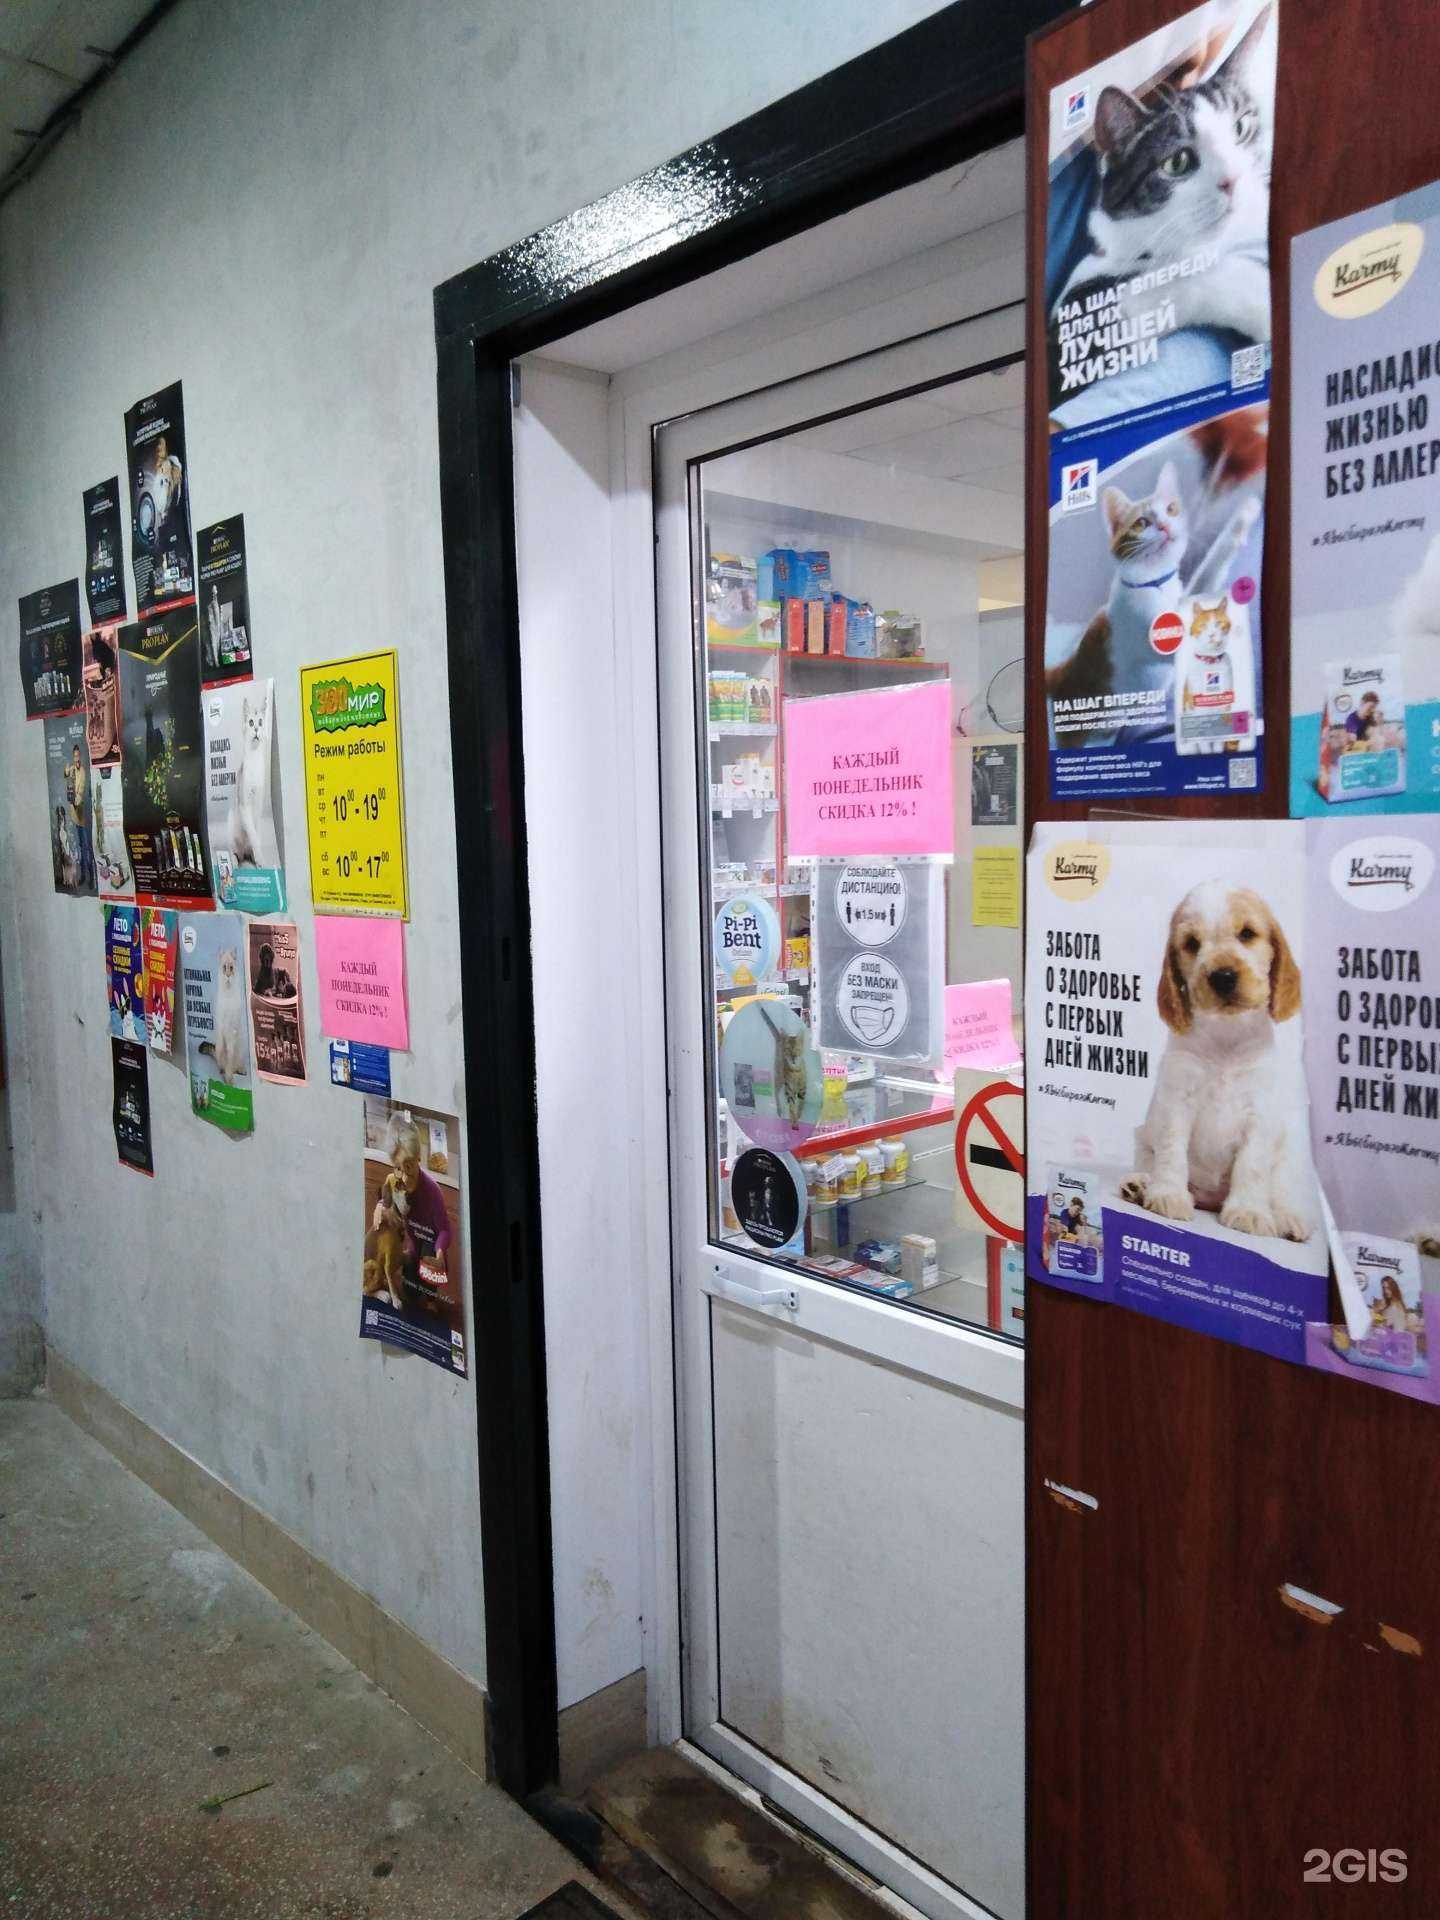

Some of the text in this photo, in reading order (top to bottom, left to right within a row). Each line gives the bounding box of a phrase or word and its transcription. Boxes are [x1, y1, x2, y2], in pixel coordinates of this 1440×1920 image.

[1335, 253, 1401, 288] Karmy
[1058, 250, 1219, 323] НА ШАГ ВПЕРЕДИ
[1058, 306, 1123, 344] ДЛЯ ИХ
[1059, 299, 1177, 366] ЛУЧШЕЙ
[1060, 337, 1159, 392] ЖИЗНИ
[1326, 394, 1428, 453] ЖИЗНЬЮ
[1326, 439, 1440, 498] БЕЗ АЛЛЕР
[1054, 690, 1167, 712] НА ШАГ ВПЕРЕДИ
[314, 739, 386, 759] Режим работы
[832, 747, 900, 770] КАЖДЫЙ
[813, 774, 924, 796] ПОНЕДЕЛЬНИК
[819, 804, 875, 820] СКИДКА
[847, 866, 896, 878] СОБЛЮДАЙТЕ
[1055, 857, 1097, 877] Karmy
[1350, 858, 1412, 881] Karmy
[724, 915, 758, 931] Pi-Pi
[723, 931, 762, 949] Bent
[1046, 930, 1100, 961] ЗАБОТА
[341, 960, 378, 977] КАЖДЫЙ
[861, 962, 881, 974] ВХОД
[1338, 947, 1421, 982] ЗАБОТА
[331, 979, 390, 998] ПОНЕДЕЛЬНИК
[848, 974, 898, 990] БЕЗ МАСКИ
[1046, 966, 1141, 1002] О ЗДОРОВЬЕ
[336, 999, 367, 1015] СКИДКА
[1046, 1002, 1123, 1038] С ПЕРВЫХ
[1338, 990, 1350, 1022] О
[1045, 1036, 1149, 1078] ДНЕЙ ЖИЗНИ
[1338, 1033, 1350, 1065] С
[1336, 1073, 1395, 1113] ДНЕЙ
[1122, 1235, 1190, 1267] STARTER
